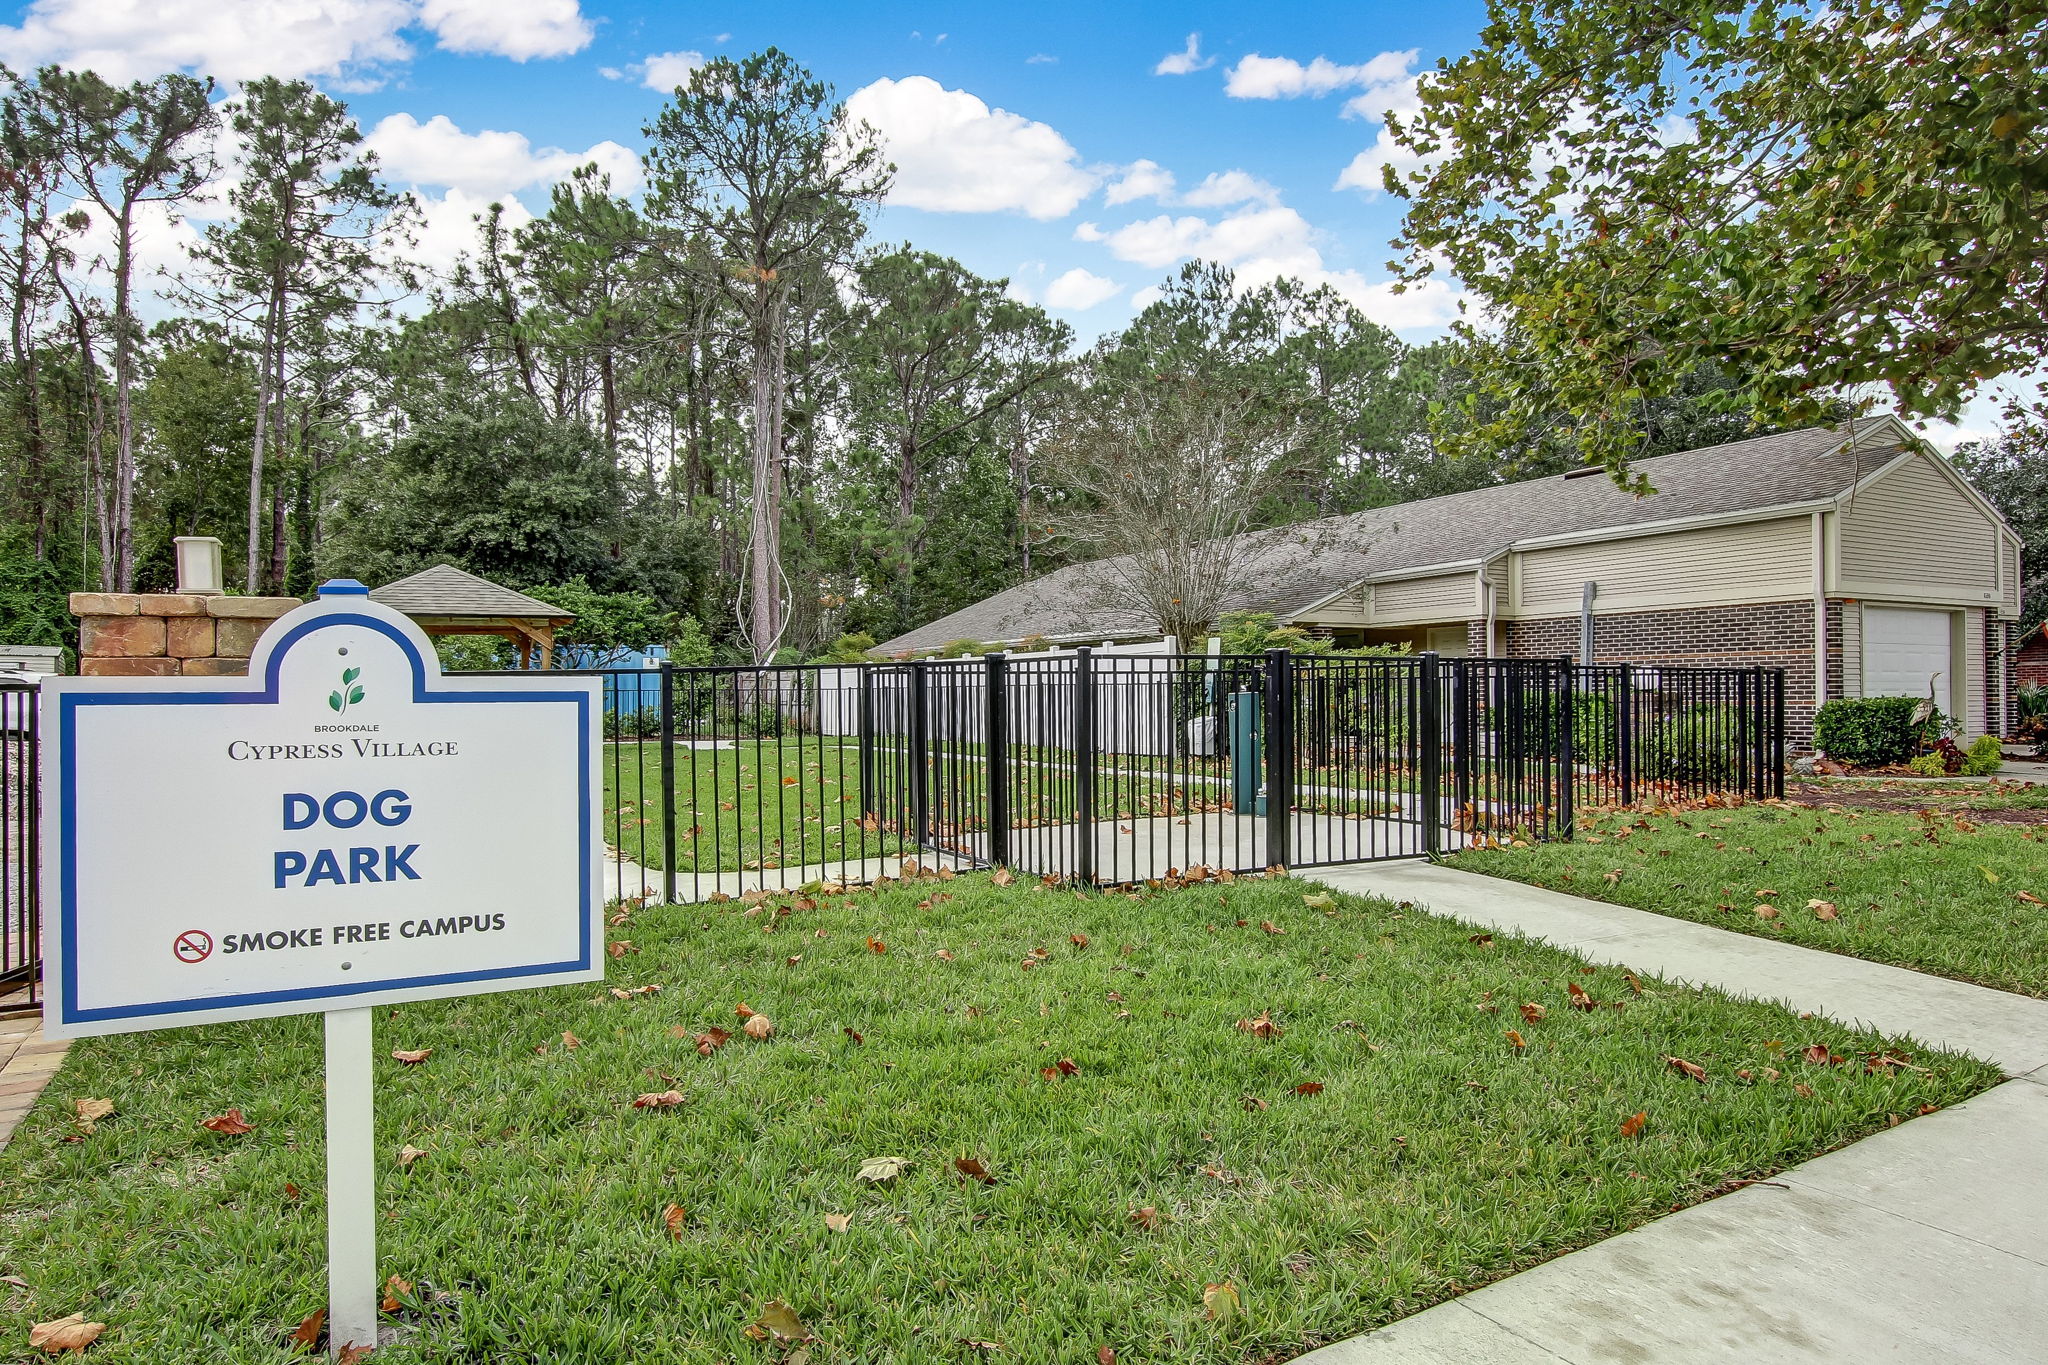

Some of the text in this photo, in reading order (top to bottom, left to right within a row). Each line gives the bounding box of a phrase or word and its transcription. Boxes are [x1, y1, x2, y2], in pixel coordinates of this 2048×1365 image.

[314, 724, 380, 733] BROOKDALE
[282, 789, 413, 831] DOG
[273, 843, 423, 889] PARK
[222, 913, 506, 954] SMOKE FREE CAMPUS
